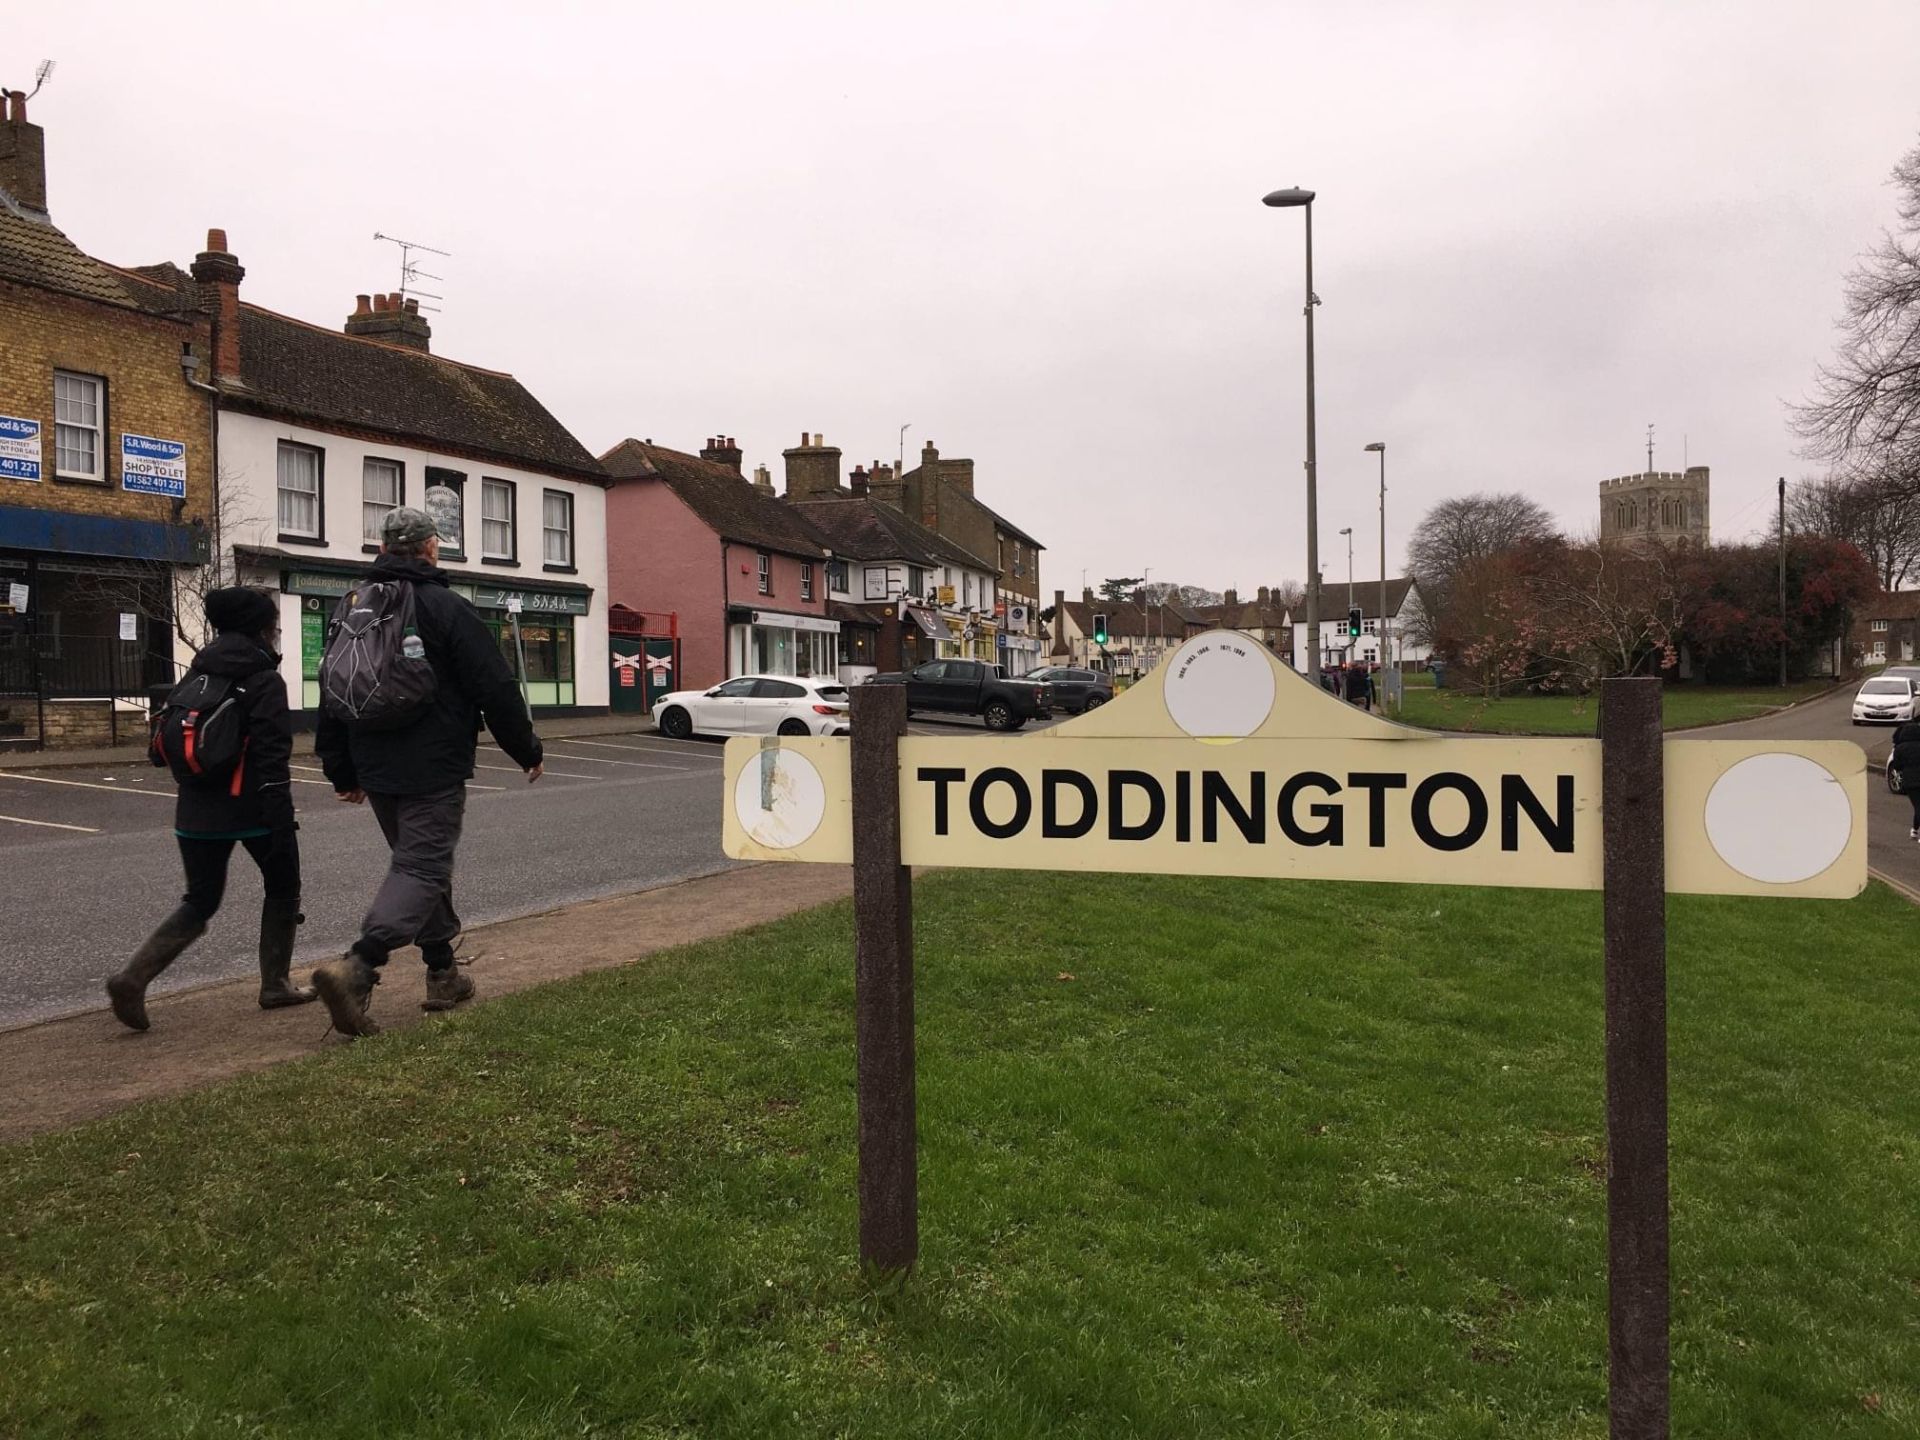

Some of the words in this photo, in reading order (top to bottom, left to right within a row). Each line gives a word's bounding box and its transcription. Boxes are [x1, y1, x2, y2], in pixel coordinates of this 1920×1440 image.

[20, 422, 36, 434] Son
[168, 444, 182, 455] Son
[1, 459, 18, 470] 401
[20, 461, 37, 473] 221
[125, 462, 152, 473] SHOP
[153, 465, 167, 475] TO
[168, 468, 184, 478] LET
[126, 474, 152, 486] 01582
[153, 478, 167, 488] 401
[168, 480, 182, 490] 221
[532, 594, 569, 610] SNAX
[917, 766, 1575, 854] TODDINGTON
